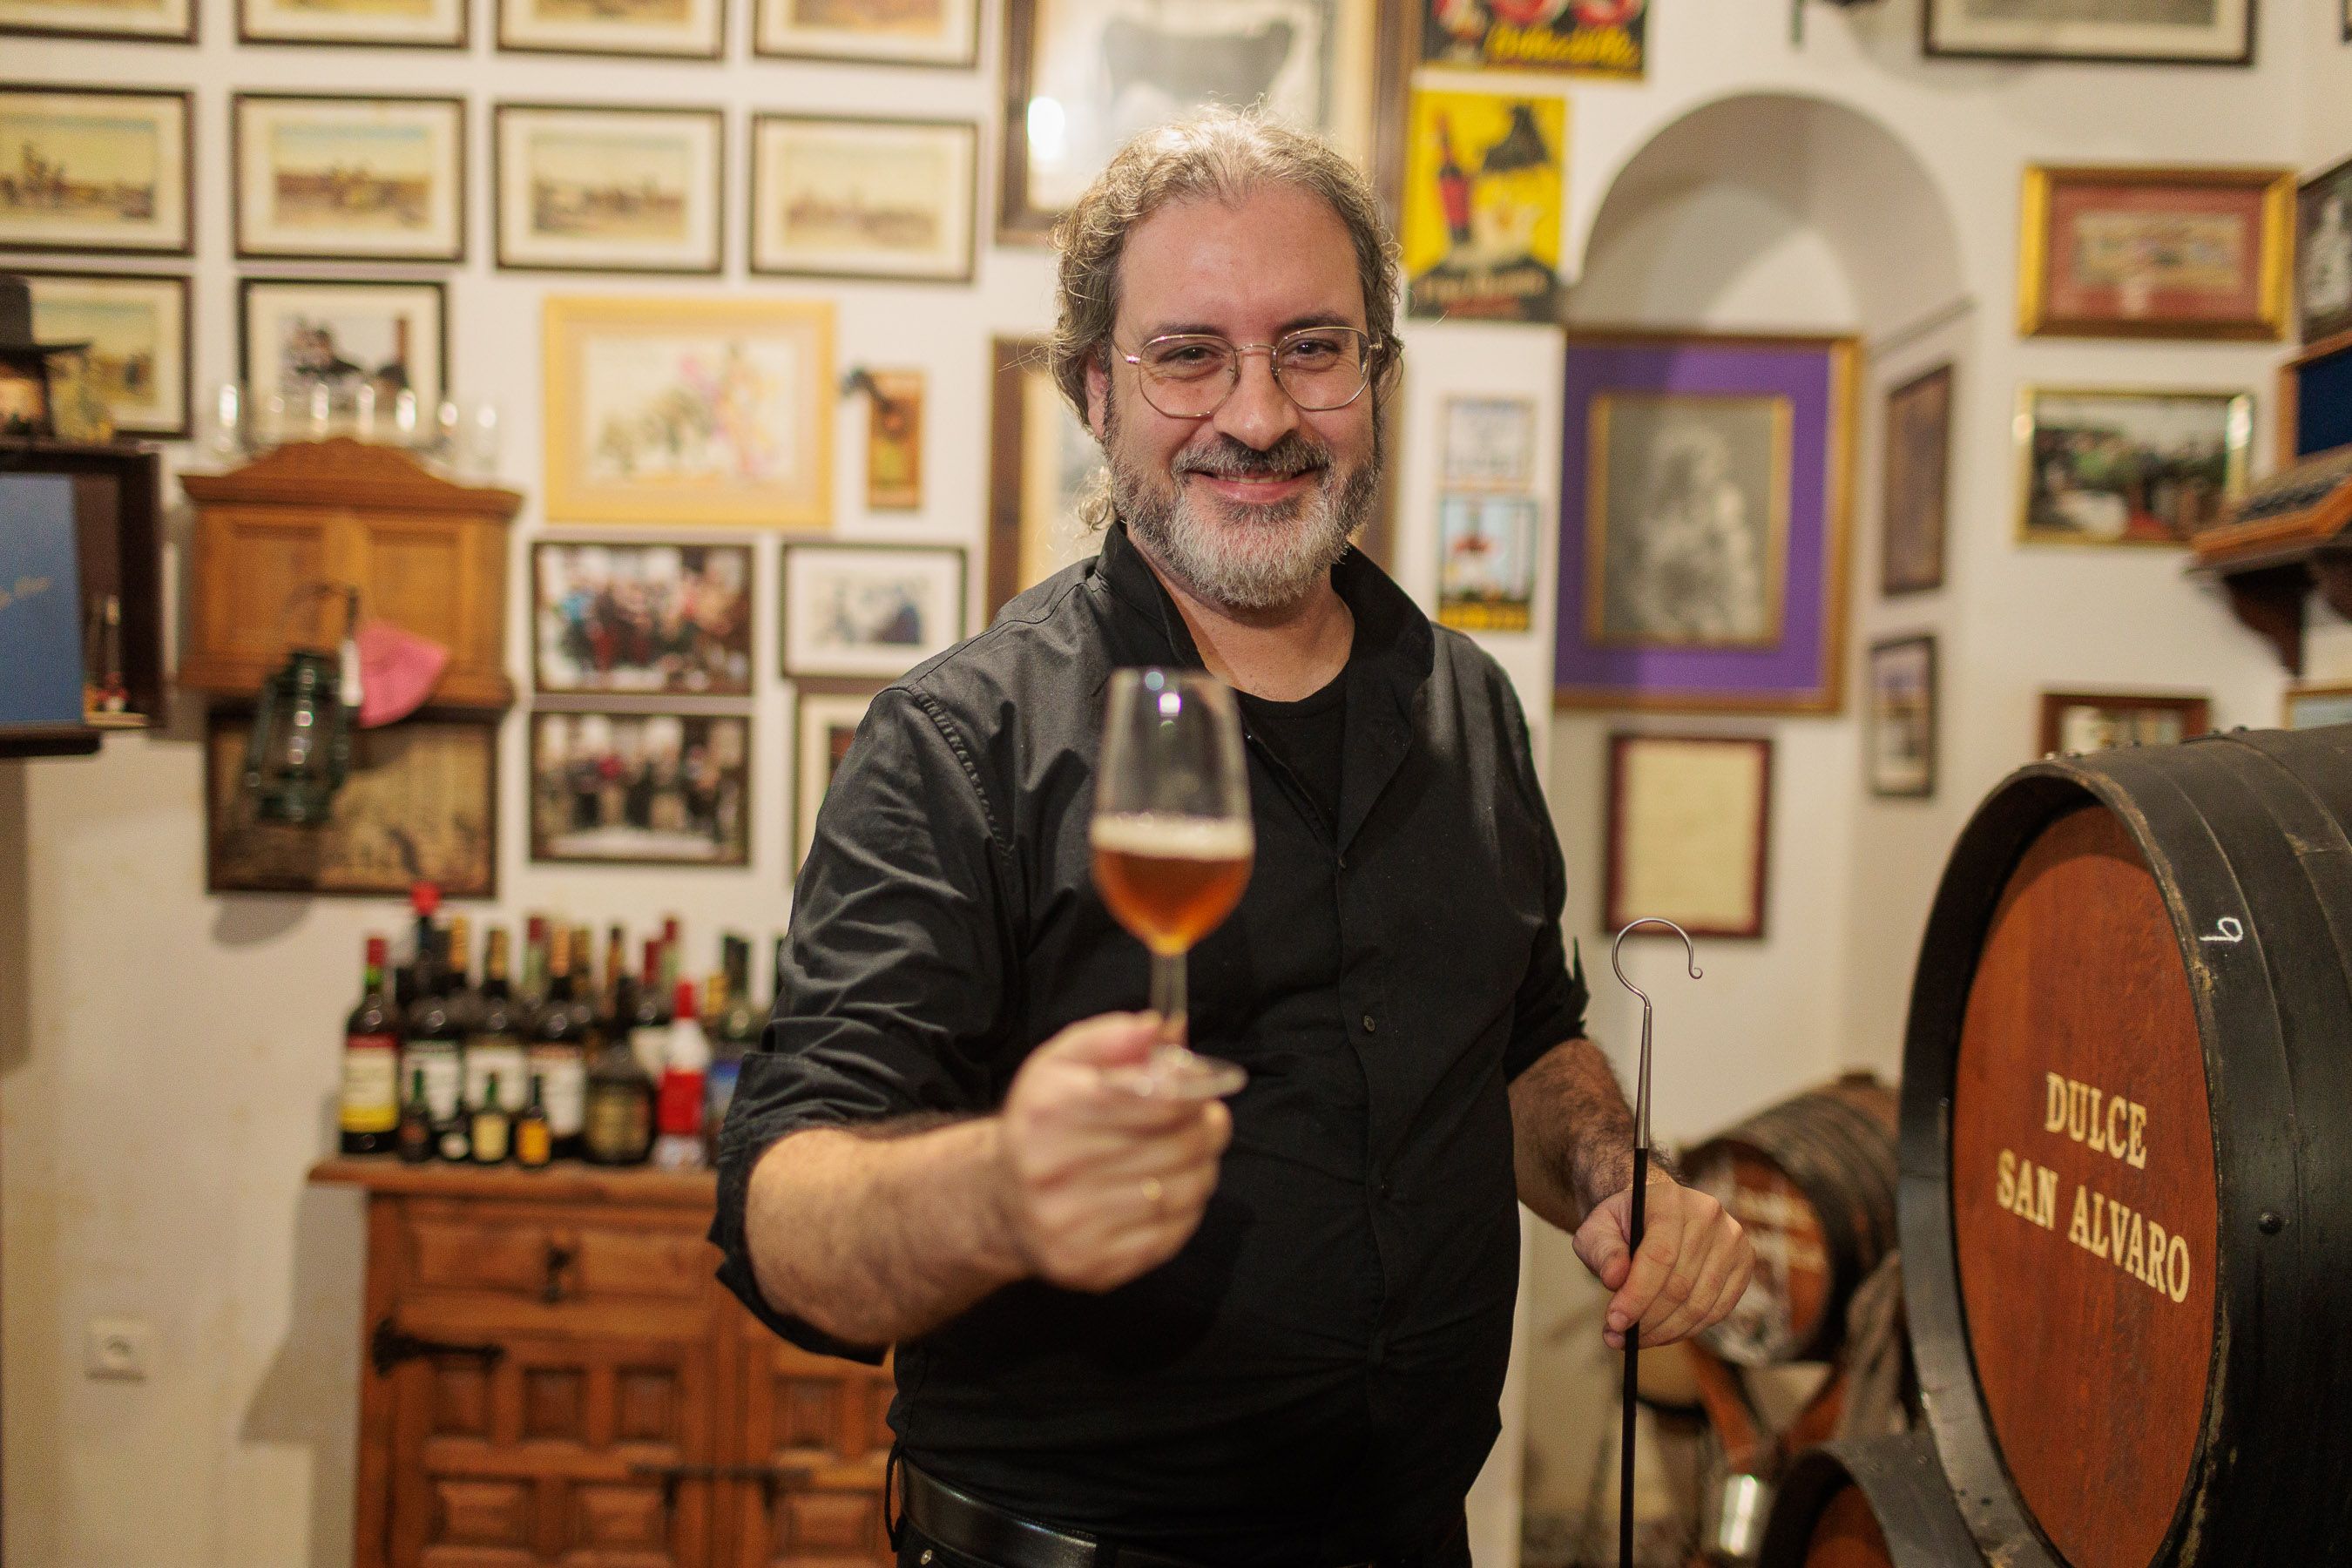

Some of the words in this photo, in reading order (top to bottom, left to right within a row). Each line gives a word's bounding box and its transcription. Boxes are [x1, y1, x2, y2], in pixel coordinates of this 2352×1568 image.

[2044, 1071, 2147, 1170] DULCE
[1996, 1148, 2058, 1231] SAN
[2068, 1185, 2191, 1303] ALVARO
